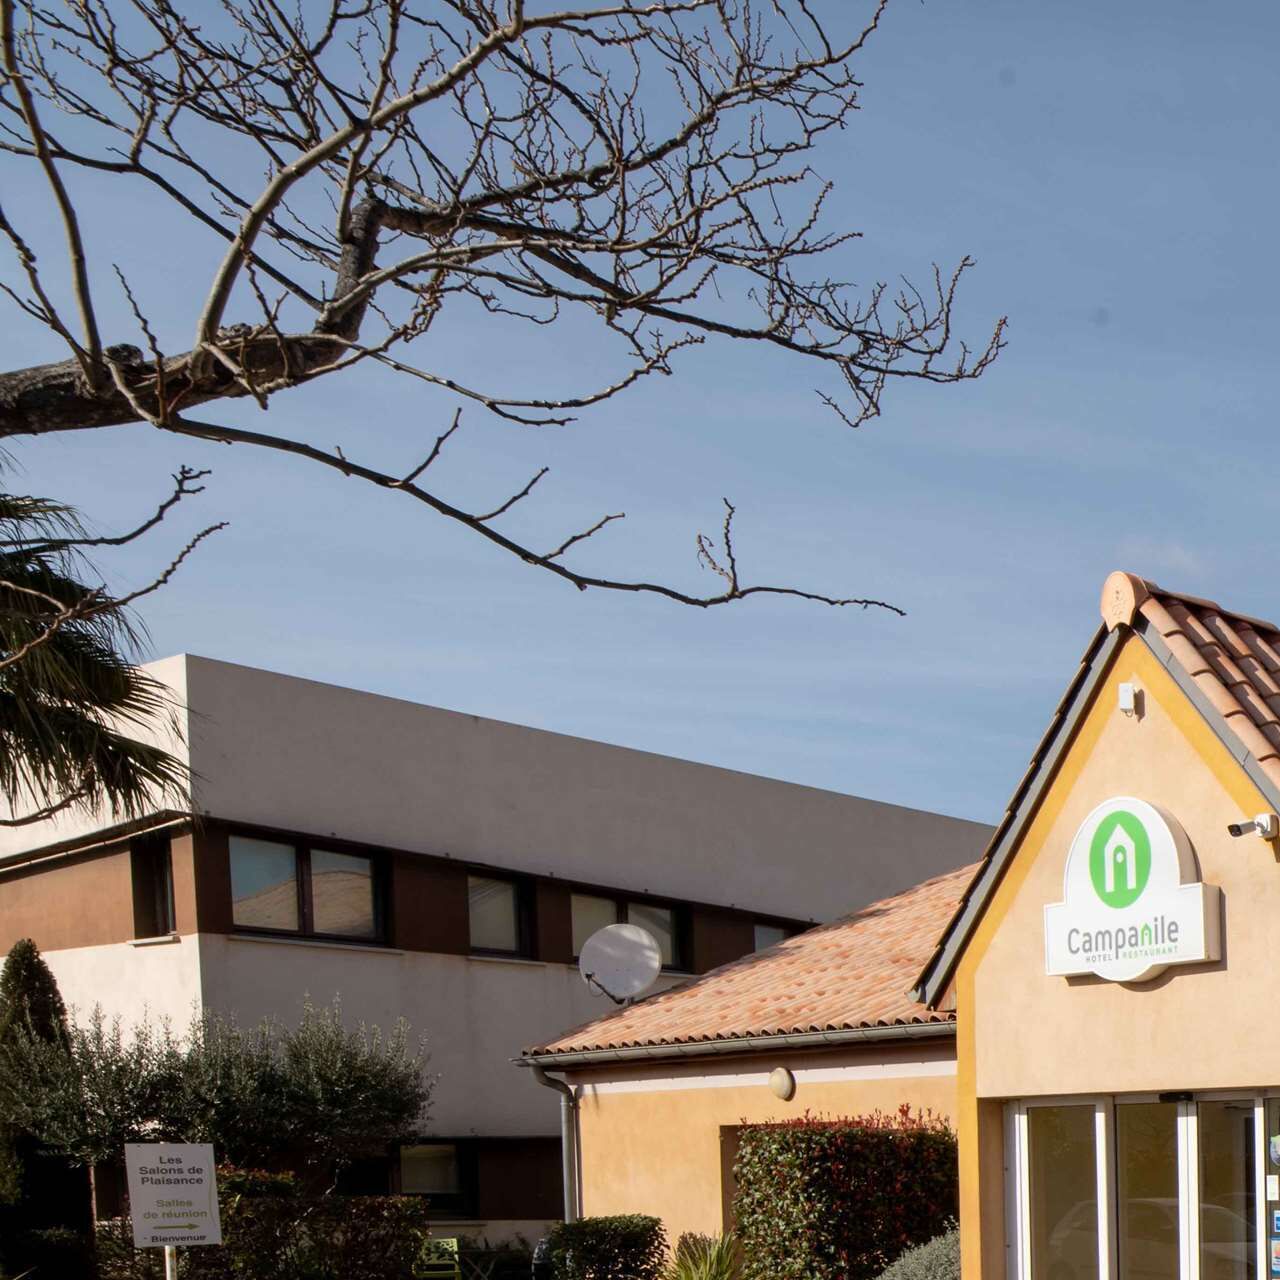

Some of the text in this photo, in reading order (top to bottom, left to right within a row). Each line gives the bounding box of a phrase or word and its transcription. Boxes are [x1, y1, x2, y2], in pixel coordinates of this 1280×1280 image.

[1067, 915, 1179, 960] Campanile
[1086, 945, 1179, 963] HOTEL RESTAURANT
[159, 1155, 183, 1165] Les
[139, 1166, 204, 1175] Salons de
[141, 1176, 204, 1185] Plaisance
[156, 1199, 193, 1208] Salles
[143, 1211, 158, 1220] de
[151, 1235, 207, 1243] Bienvenue
